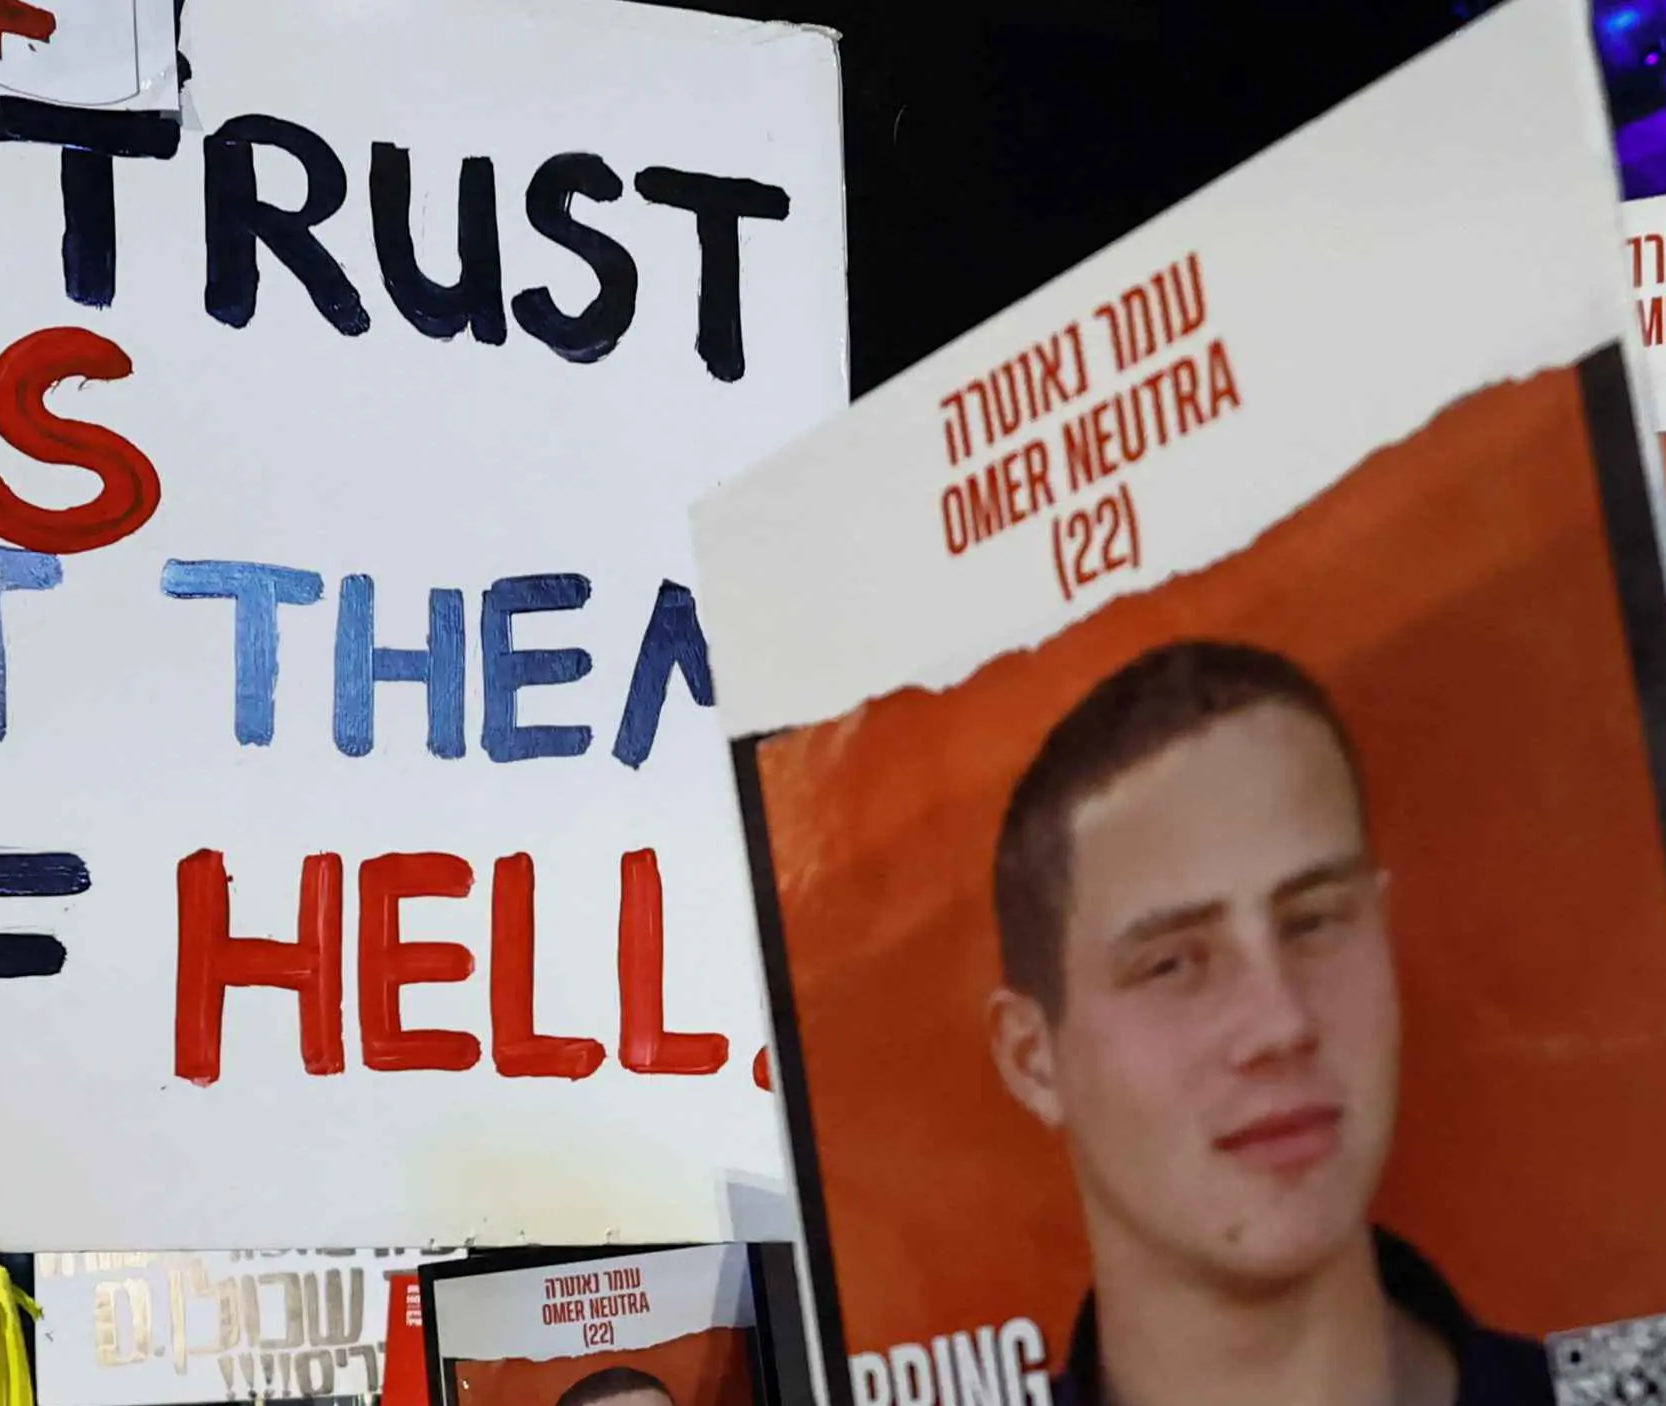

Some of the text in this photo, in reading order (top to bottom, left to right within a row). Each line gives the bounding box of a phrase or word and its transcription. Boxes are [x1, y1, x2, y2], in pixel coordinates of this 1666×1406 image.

[939, 251, 1207, 467] עומר נאוטרה
[941, 337, 1242, 557] OMER NEUTRA
[1052, 482, 1140, 601] (22)
[174, 848, 774, 1087] HELL.
[542, 1291, 650, 1326] OMER NEUTRA
[544, 1267, 641, 1300] עומר נאוטרה
[583, 1321, 614, 1348] (22)
